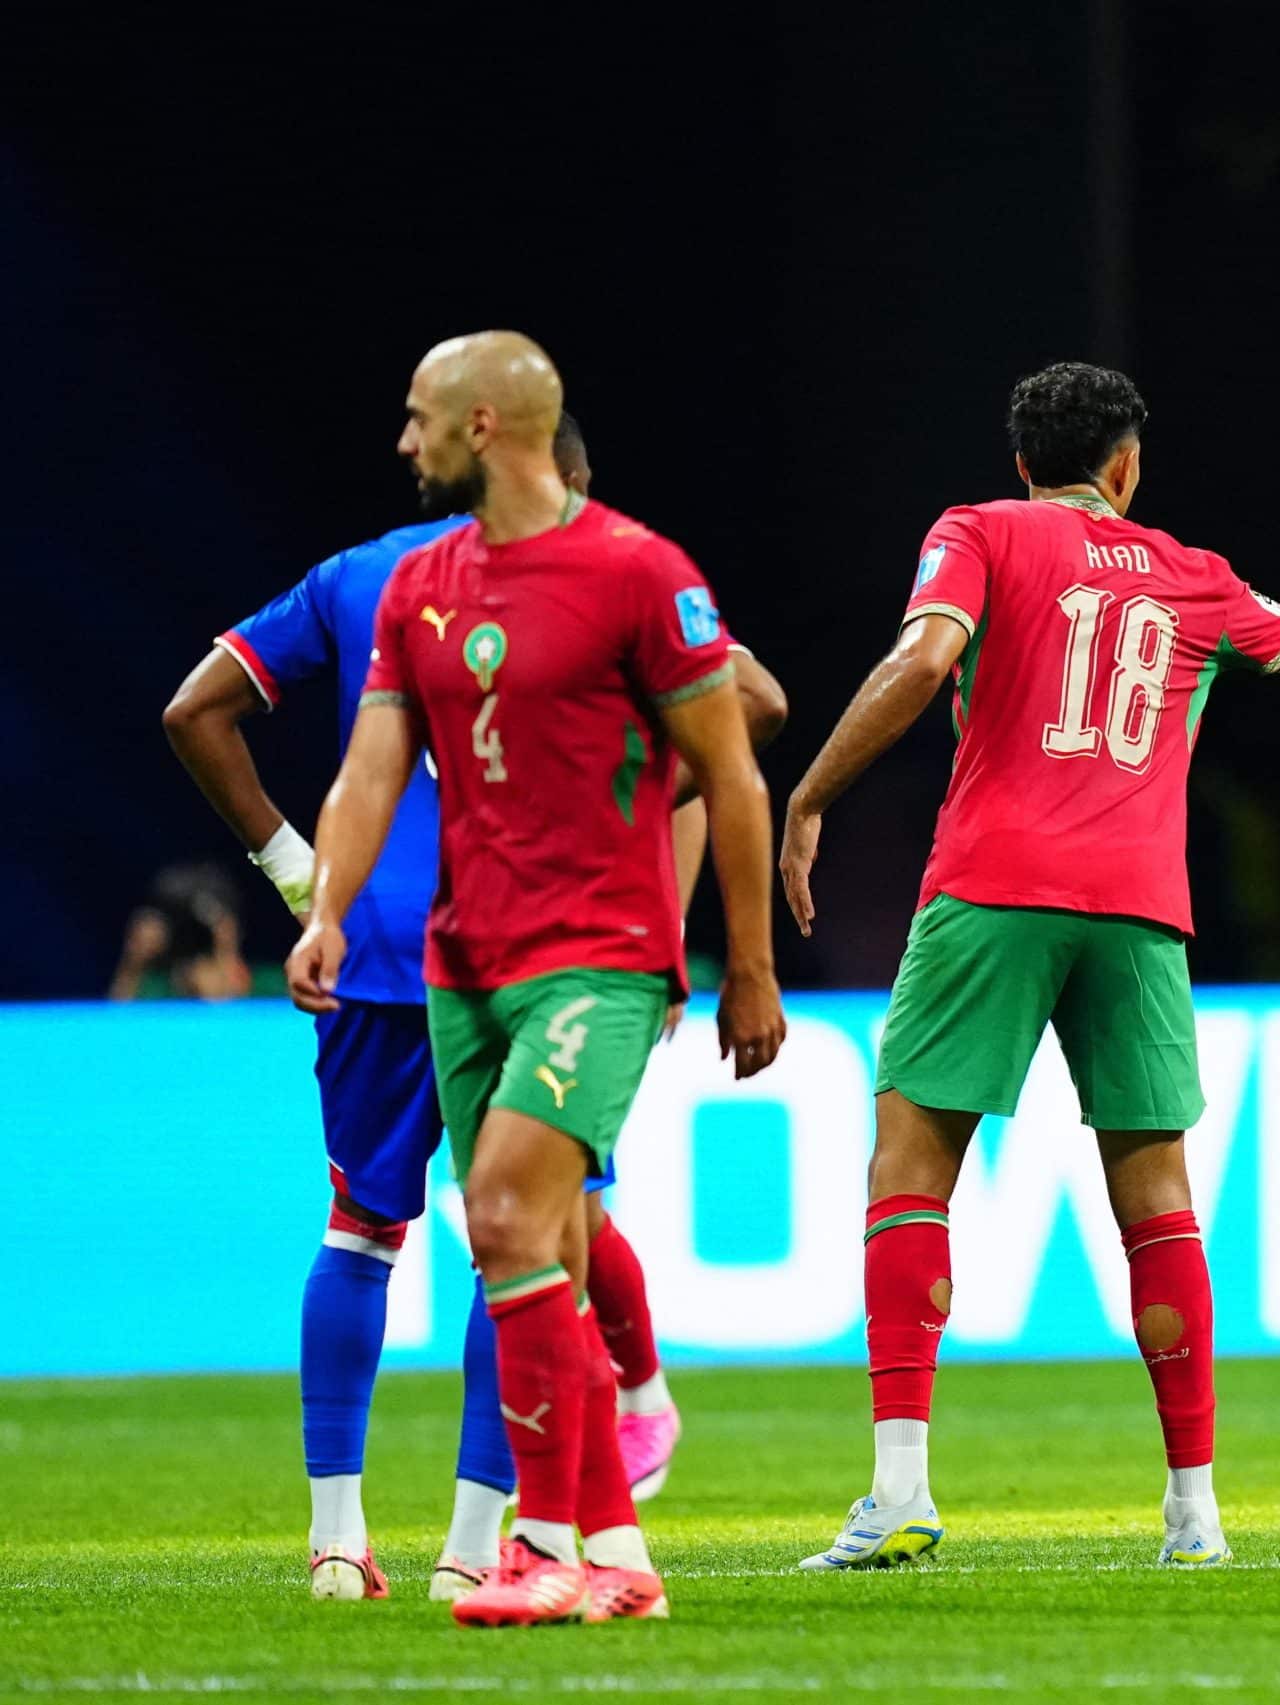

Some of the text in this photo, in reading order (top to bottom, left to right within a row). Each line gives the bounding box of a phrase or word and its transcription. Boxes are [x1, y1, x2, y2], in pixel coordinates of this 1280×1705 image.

[1083, 539, 1152, 574] RIAD
[1041, 582, 1181, 776] 18
[471, 692, 508, 783] 4
[545, 994, 598, 1073] 4
